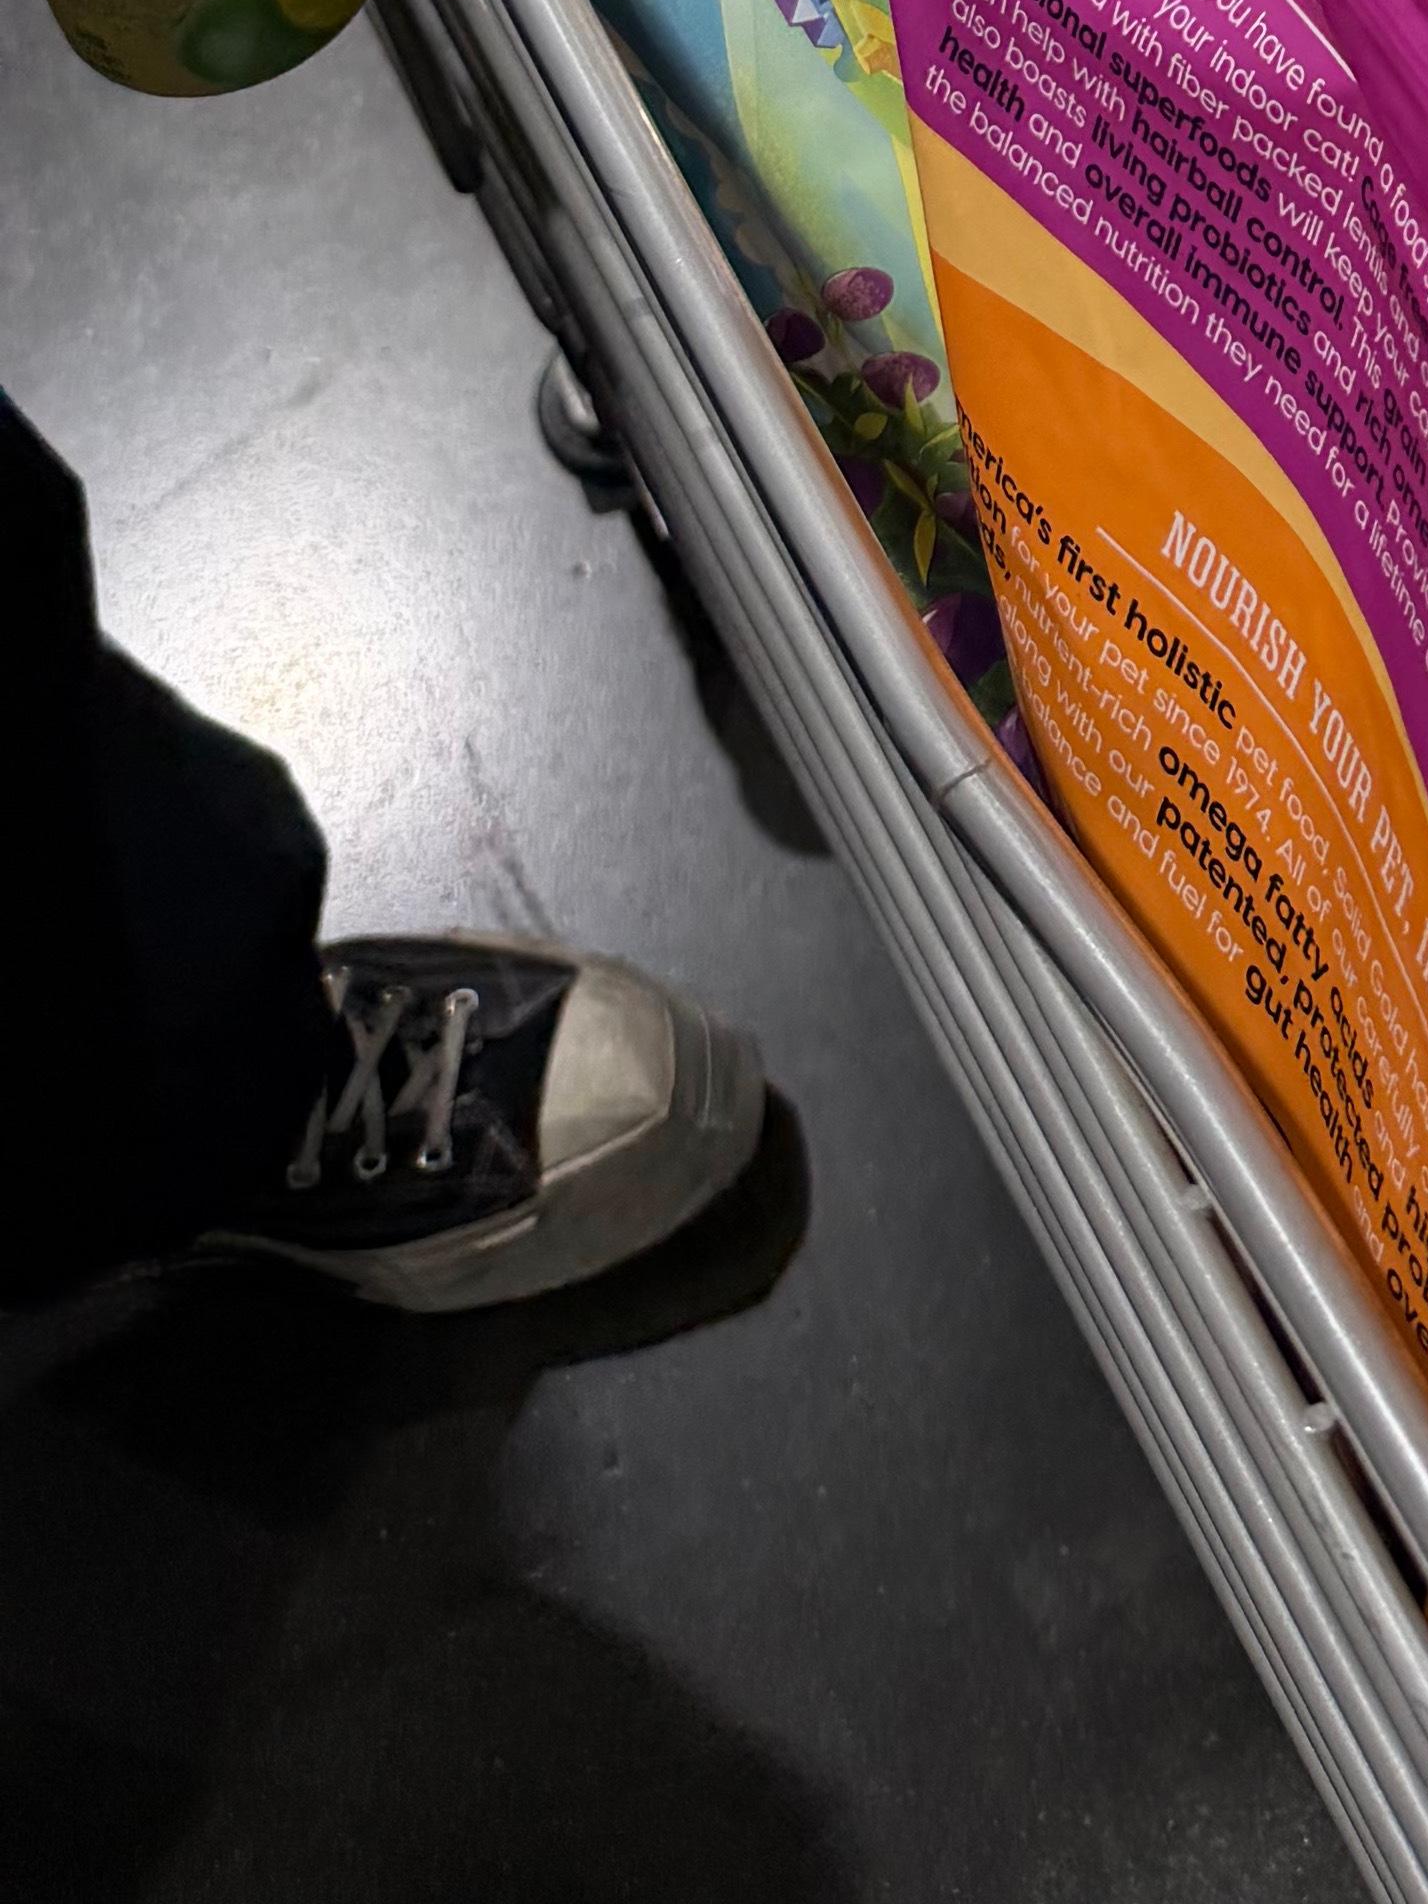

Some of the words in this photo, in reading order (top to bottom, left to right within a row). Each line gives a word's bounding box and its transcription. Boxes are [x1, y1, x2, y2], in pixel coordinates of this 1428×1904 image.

[939, 26, 1026, 121] health
[1029, 112, 1082, 168] and
[1085, 163, 1182, 260] overall
[1185, 250, 1303, 374] immune
[1012, 1, 1065, 64] help
[1072, 56, 1126, 121] with
[1131, 110, 1243, 222] hairball
[1246, 217, 1345, 330] control.
[1107, 58, 1272, 203] superfoods
[1278, 193, 1323, 246] will
[1111, 0, 1165, 66] with
[1167, 53, 1229, 119] fiber
[1232, 114, 1342, 215] packed
[1210, 40, 1298, 132] indoor
[1245, 11, 1307, 90] have
[1307, 79, 1385, 165] found
[926, 64, 967, 115] the
[970, 104, 1091, 223] balanced
[1095, 216, 1202, 325] nutrition
[1205, 312, 1263, 384] they
[1266, 376, 1325, 456] need
[1005, 40, 1087, 128] boasts
[1092, 114, 1167, 207] living
[1169, 193, 1310, 335] probiotics
[1313, 330, 1357, 394] and
[1041, 570, 1099, 643] your
[1153, 688, 1221, 764] since
[1056, 534, 1121, 616] first
[1124, 600, 1237, 731] holistic
[1160, 510, 1309, 702] NOURISH
[1307, 678, 1372, 824] YOUR
[1159, 745, 1264, 882] omega
[1267, 872, 1330, 982] fatty
[1156, 796, 1290, 986] patented,
[1294, 979, 1385, 1202] protected
[1243, 962, 1293, 1042] gut
[1294, 1030, 1355, 1185] health
